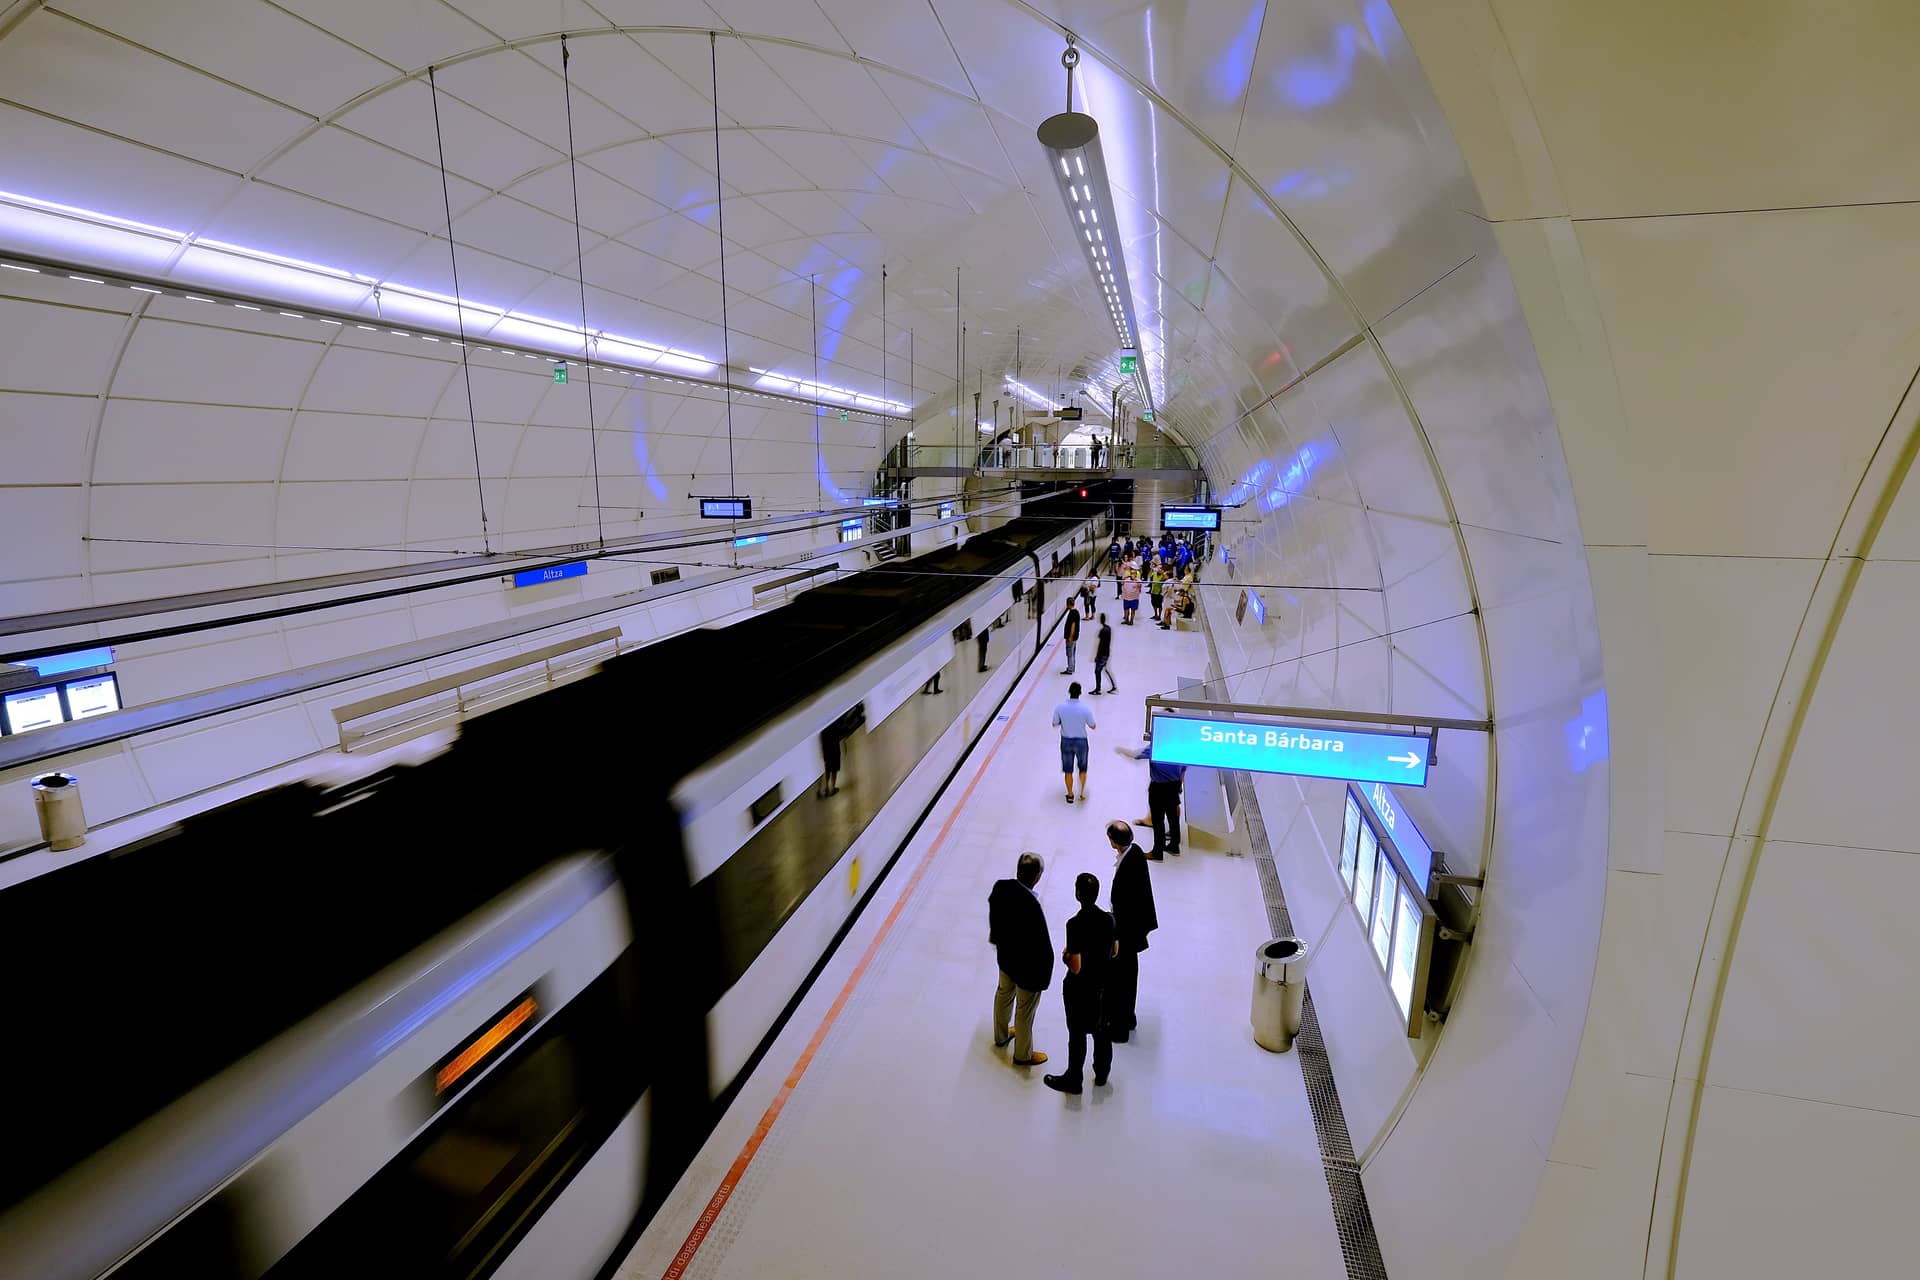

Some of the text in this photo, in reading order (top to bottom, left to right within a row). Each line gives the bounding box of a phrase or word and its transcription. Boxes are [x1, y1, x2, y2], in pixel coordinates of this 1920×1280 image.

[543, 568, 563, 580] Altza
[1200, 725, 1345, 753] Santa Bárbara
[1372, 783, 1396, 831] Altza
[676, 1209, 716, 1265] dagoenean
[711, 1183, 731, 1209] sartu
